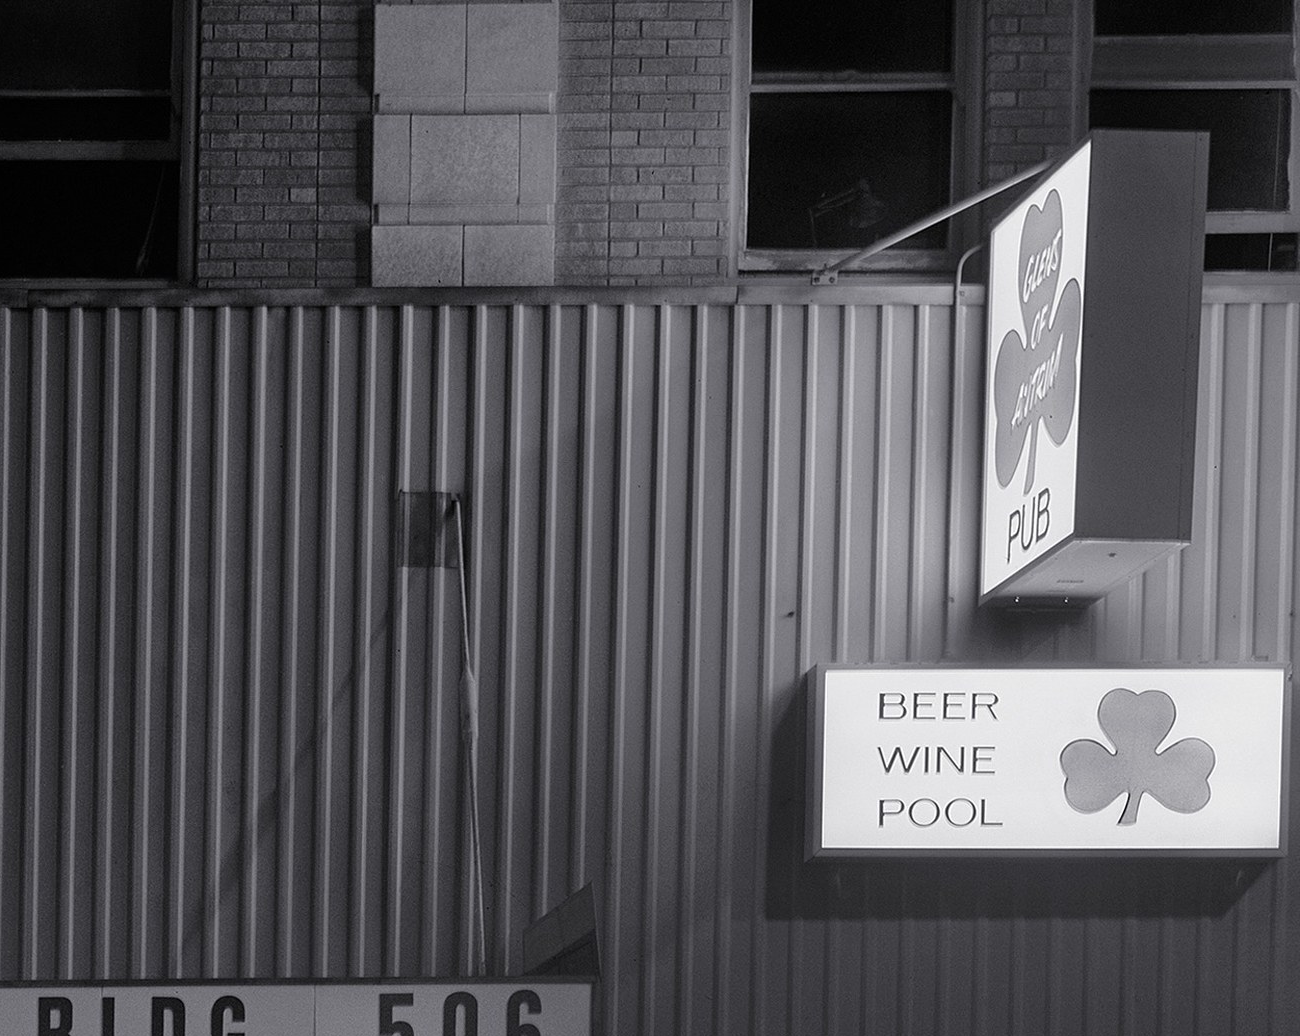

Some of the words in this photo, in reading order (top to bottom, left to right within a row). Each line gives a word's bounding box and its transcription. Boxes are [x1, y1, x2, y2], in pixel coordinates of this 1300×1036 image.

[1031, 303, 1049, 350] OF
[1007, 487, 1050, 564] PUB
[878, 692, 999, 720] BEER
[877, 746, 996, 774] WINE
[878, 797, 1003, 827] POOL
